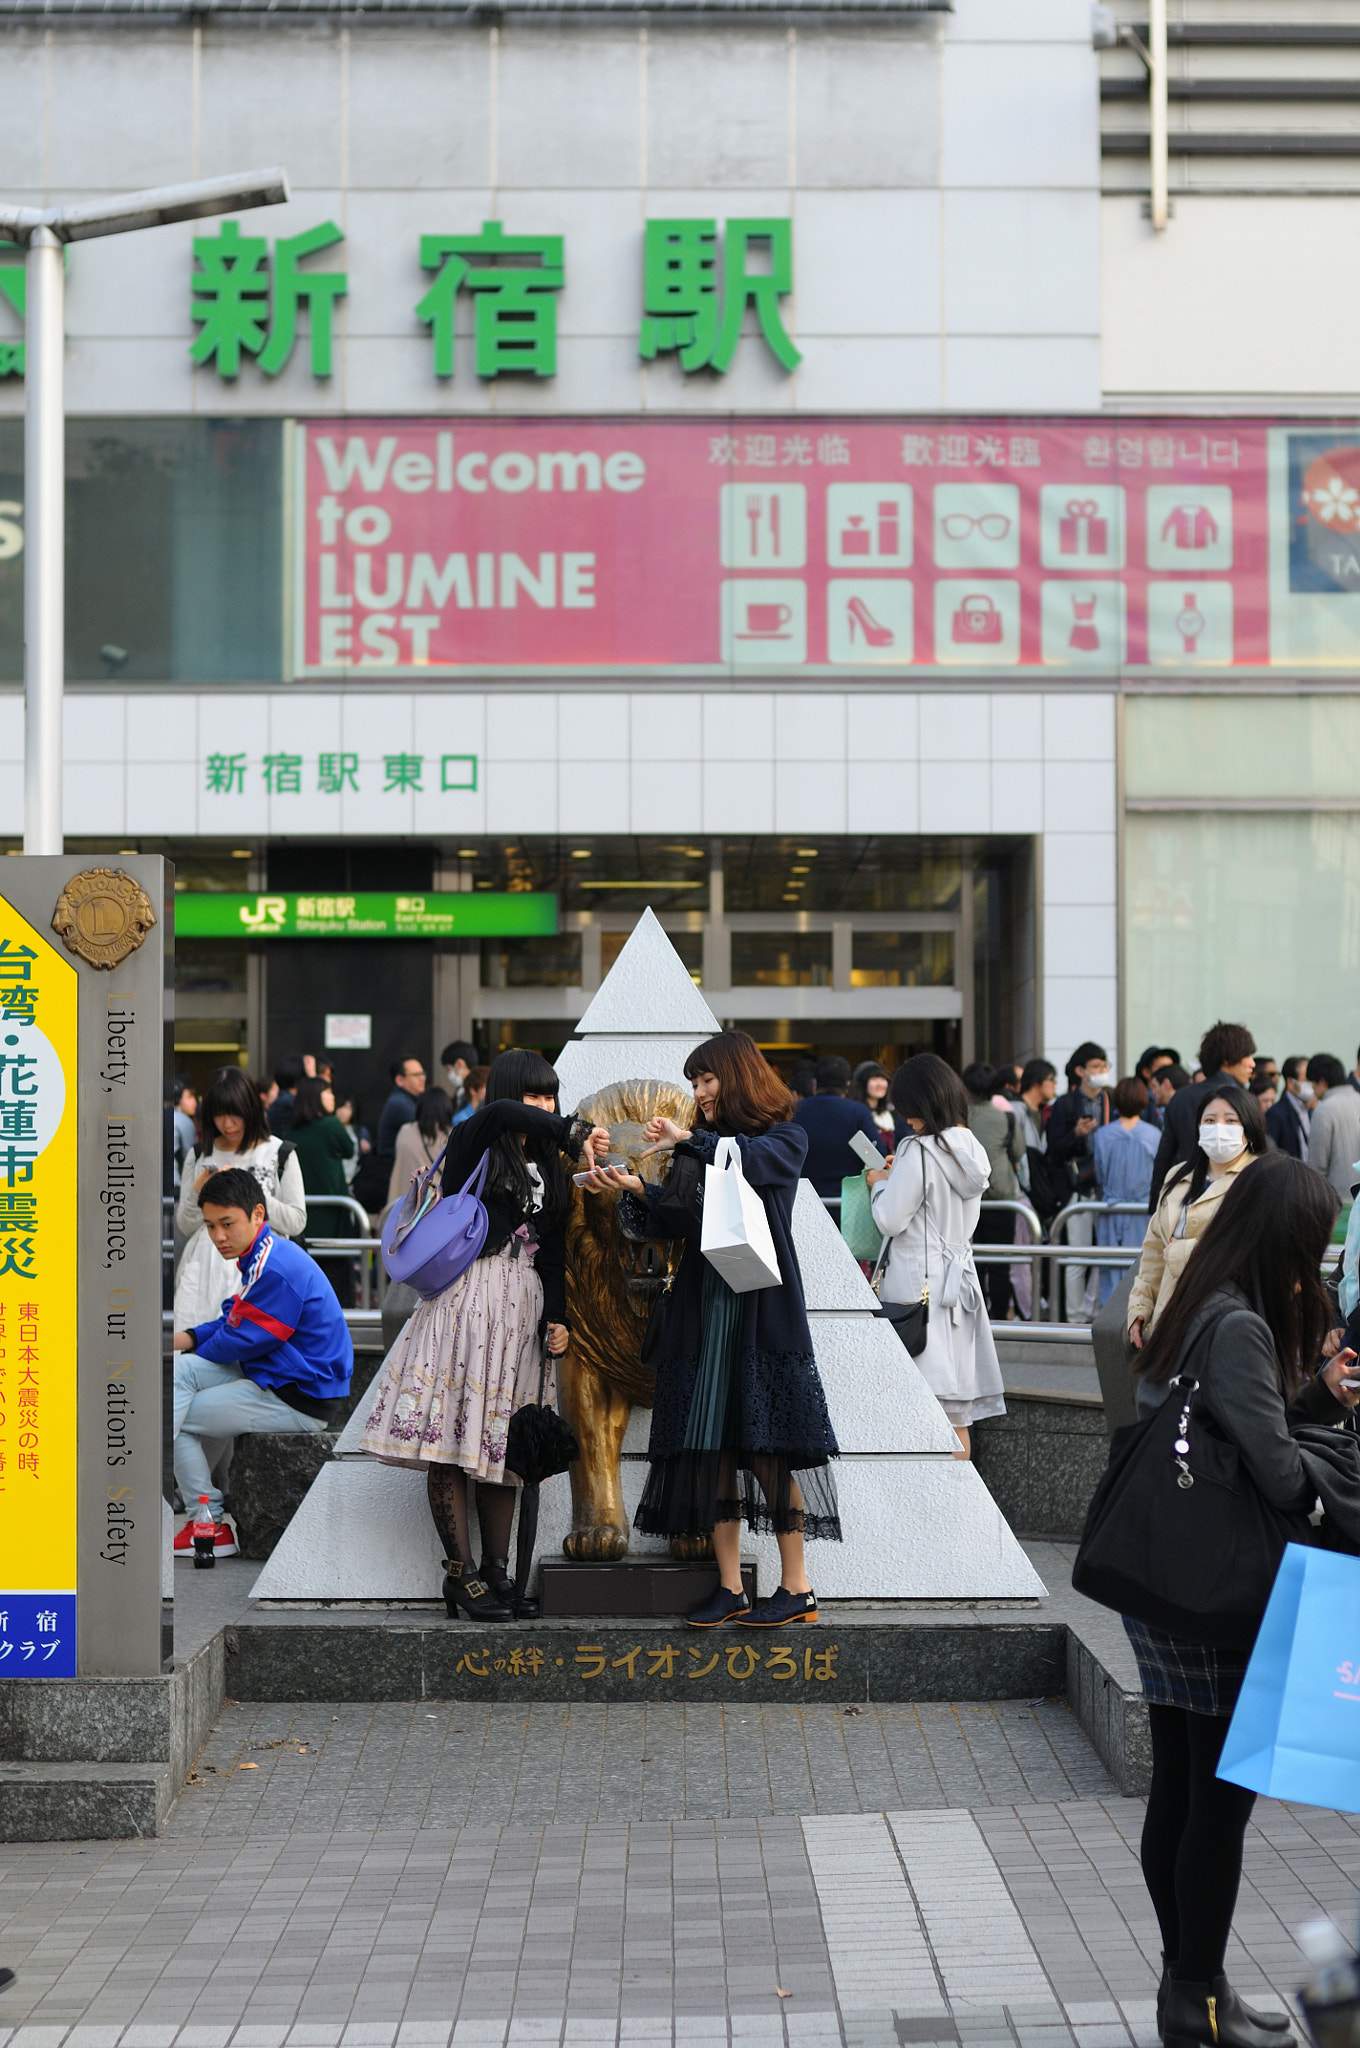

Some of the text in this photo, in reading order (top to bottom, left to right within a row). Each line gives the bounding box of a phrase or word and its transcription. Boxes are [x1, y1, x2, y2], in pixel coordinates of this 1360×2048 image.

[190, 219, 803, 379] 新宿駅
[315, 432, 646, 492] Welcome
[708, 434, 851, 467] 欢迎光临
[902, 435, 1042, 468] 歡迎光臨
[1083, 436, 1242, 469] 환영합니다
[316, 496, 393, 546] to
[319, 552, 595, 610] LUMINE
[319, 614, 441, 667] EST
[206, 753, 478, 793] 新宿駅東口
[91, 901, 117, 936] L
[240, 896, 287, 924] JR
[101, 993, 135, 1566] Liberty, Intelligence, Our Nation's Safety
[18, 1302, 40, 1480] 東日本大震災の時、
[456, 1644, 839, 1681] 心の絆・ライオンひろば
